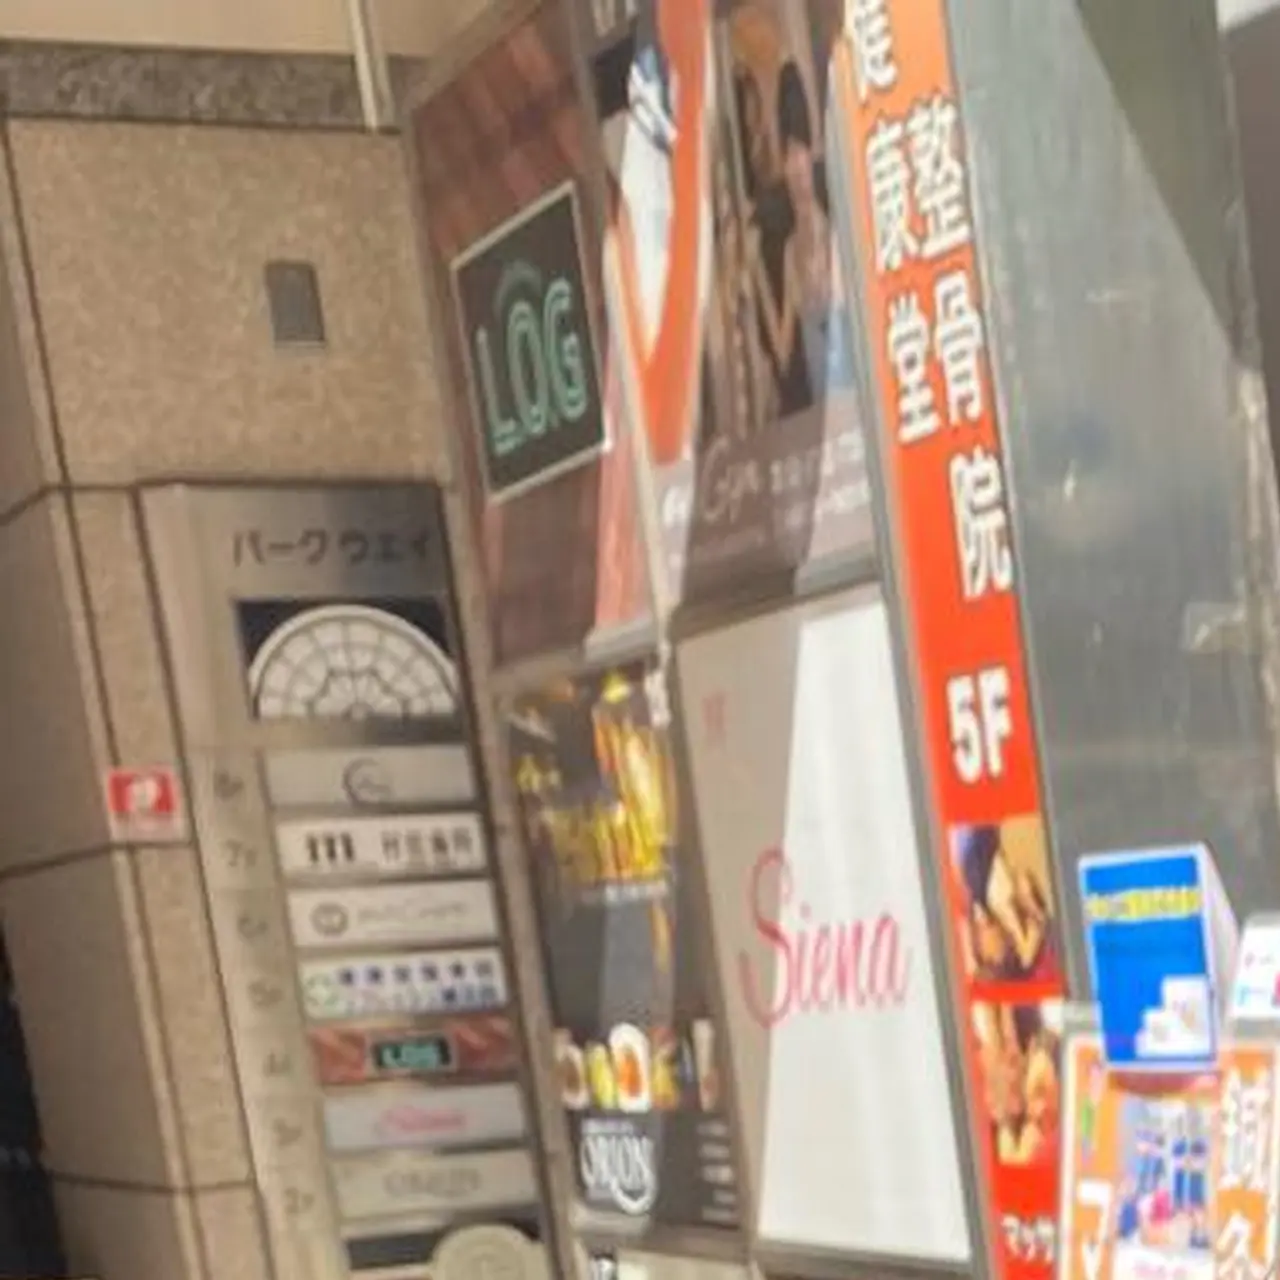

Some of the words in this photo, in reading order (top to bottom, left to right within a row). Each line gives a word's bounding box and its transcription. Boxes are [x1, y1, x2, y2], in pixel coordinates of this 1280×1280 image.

[474, 276, 588, 455] LOG
[906, 95, 1013, 602] 整骨院
[946, 667, 1012, 783] 5F
[738, 844, 910, 1030] Siena
